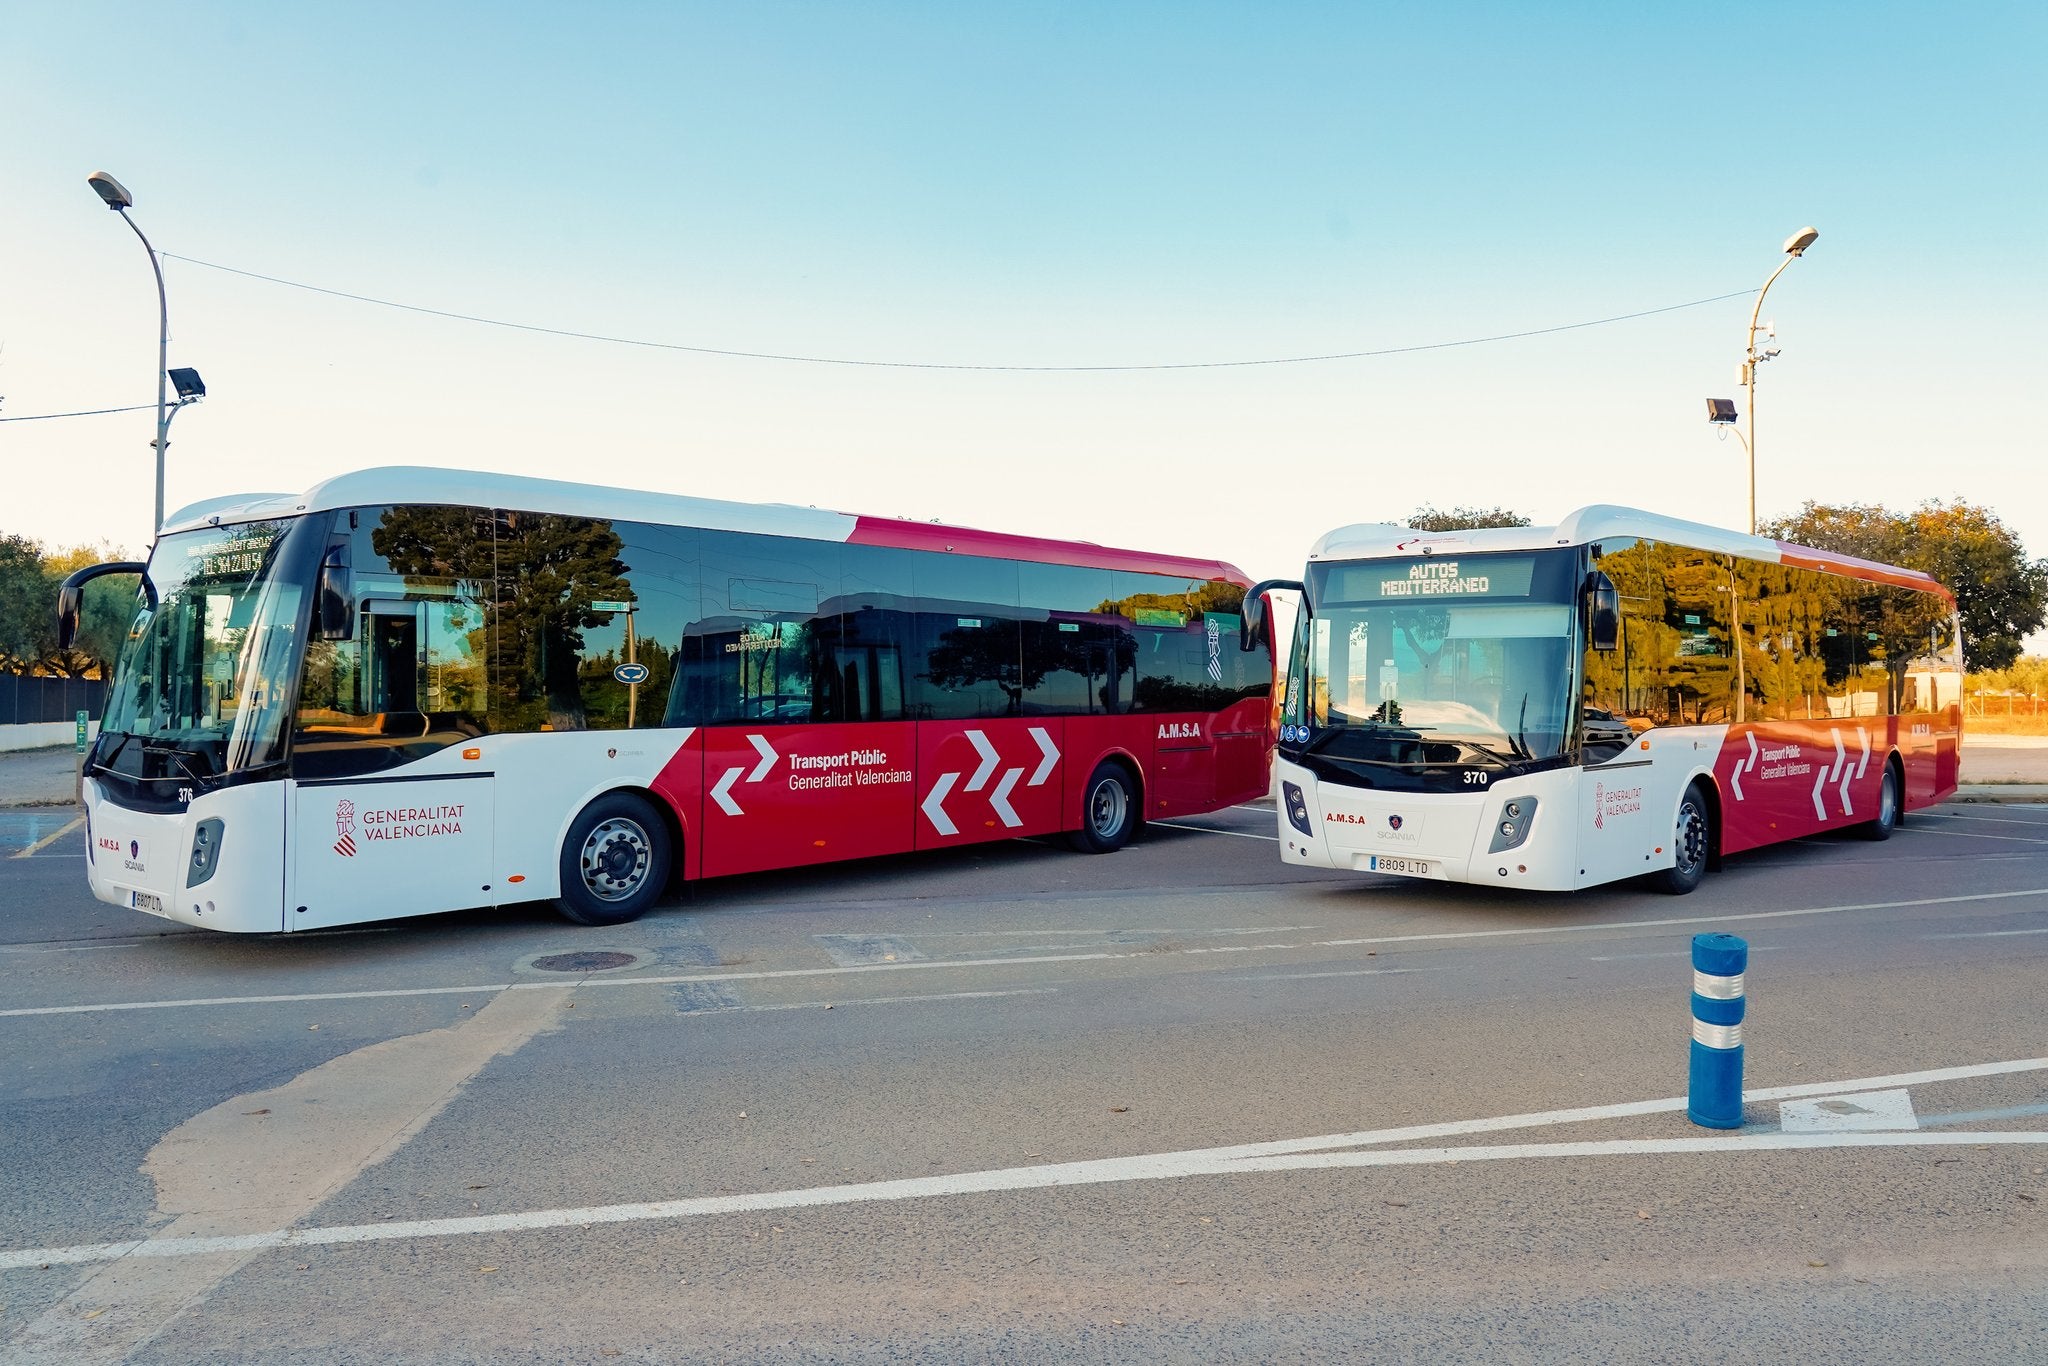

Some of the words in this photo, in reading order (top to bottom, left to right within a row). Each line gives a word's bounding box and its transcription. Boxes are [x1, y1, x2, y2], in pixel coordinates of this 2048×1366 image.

[1409, 562, 1459, 579] AUTOS
[1381, 577, 1489, 596] MEDITERRANEO
[1158, 722, 1201, 739] A.M.S.A
[789, 753, 850, 771] Transport
[850, 749, 888, 766] Públic
[1761, 747, 1786, 764] Transport
[788, 771, 853, 791] Generalitat
[855, 768, 912, 786] Valenciana
[1463, 771, 1488, 784] 370
[1760, 764, 1787, 780] Generalitat
[178, 787, 194, 803] 376
[1605, 788, 1643, 803] GENERALITAT
[363, 805, 465, 825] GENERALITAT
[1605, 802, 1641, 817] VALENCIANA
[1326, 813, 1366, 825] A.M.S.A
[364, 822, 463, 841] VALENCIANA
[1376, 830, 1416, 842] SCANIA
[99, 838, 120, 852] A.M.S.A
[124, 859, 145, 873] SCANIA
[1379, 858, 1405, 872] 6809
[1407, 861, 1428, 875] LTD
